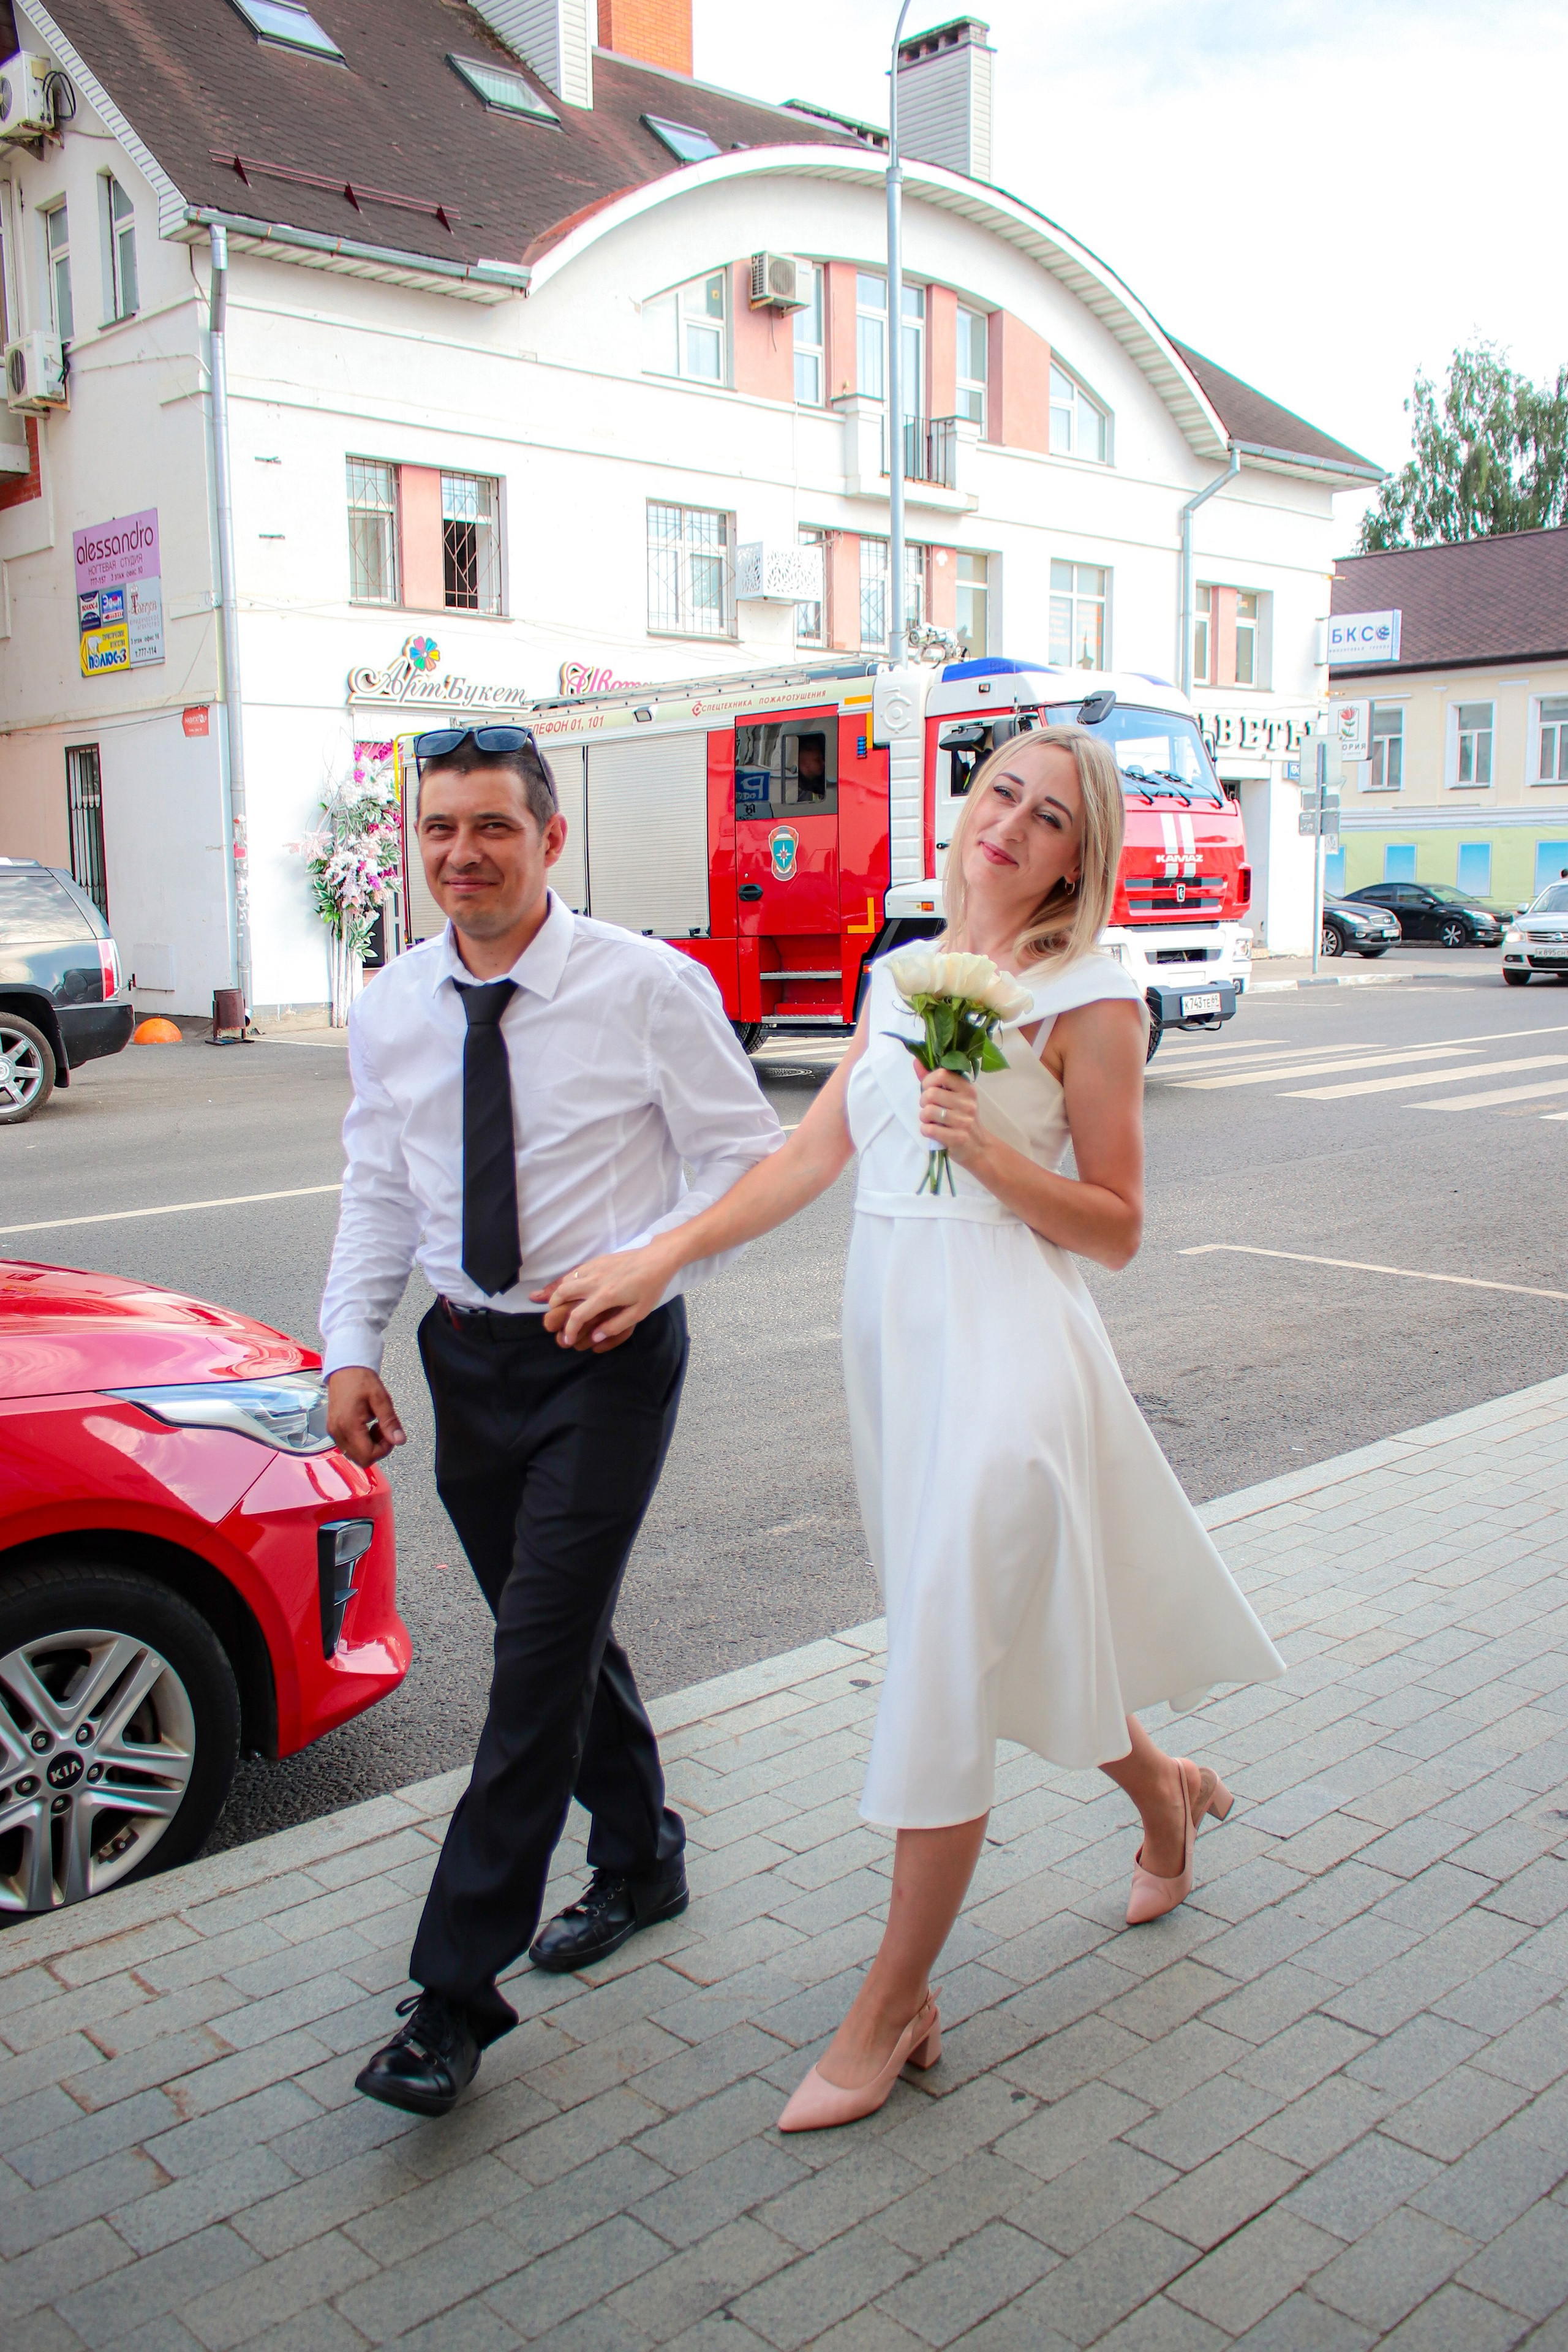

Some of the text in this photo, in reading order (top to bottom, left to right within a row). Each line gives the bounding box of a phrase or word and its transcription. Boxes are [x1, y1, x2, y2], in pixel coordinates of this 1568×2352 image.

[77, 521, 154, 565] alessandro
[88, 553, 143, 576] НОГТЕВАЯ СТУДИЯ
[1332, 625, 1374, 644] БКС
[701, 690, 826, 712] СПЕЦТЕХНИКА ПОЖАРОТУШЕНИЯ
[570, 717, 584, 731] 01,
[588, 715, 605, 729] 101
[1156, 854, 1204, 863] KAMAZ
[50, 1760, 81, 1783] KIA
